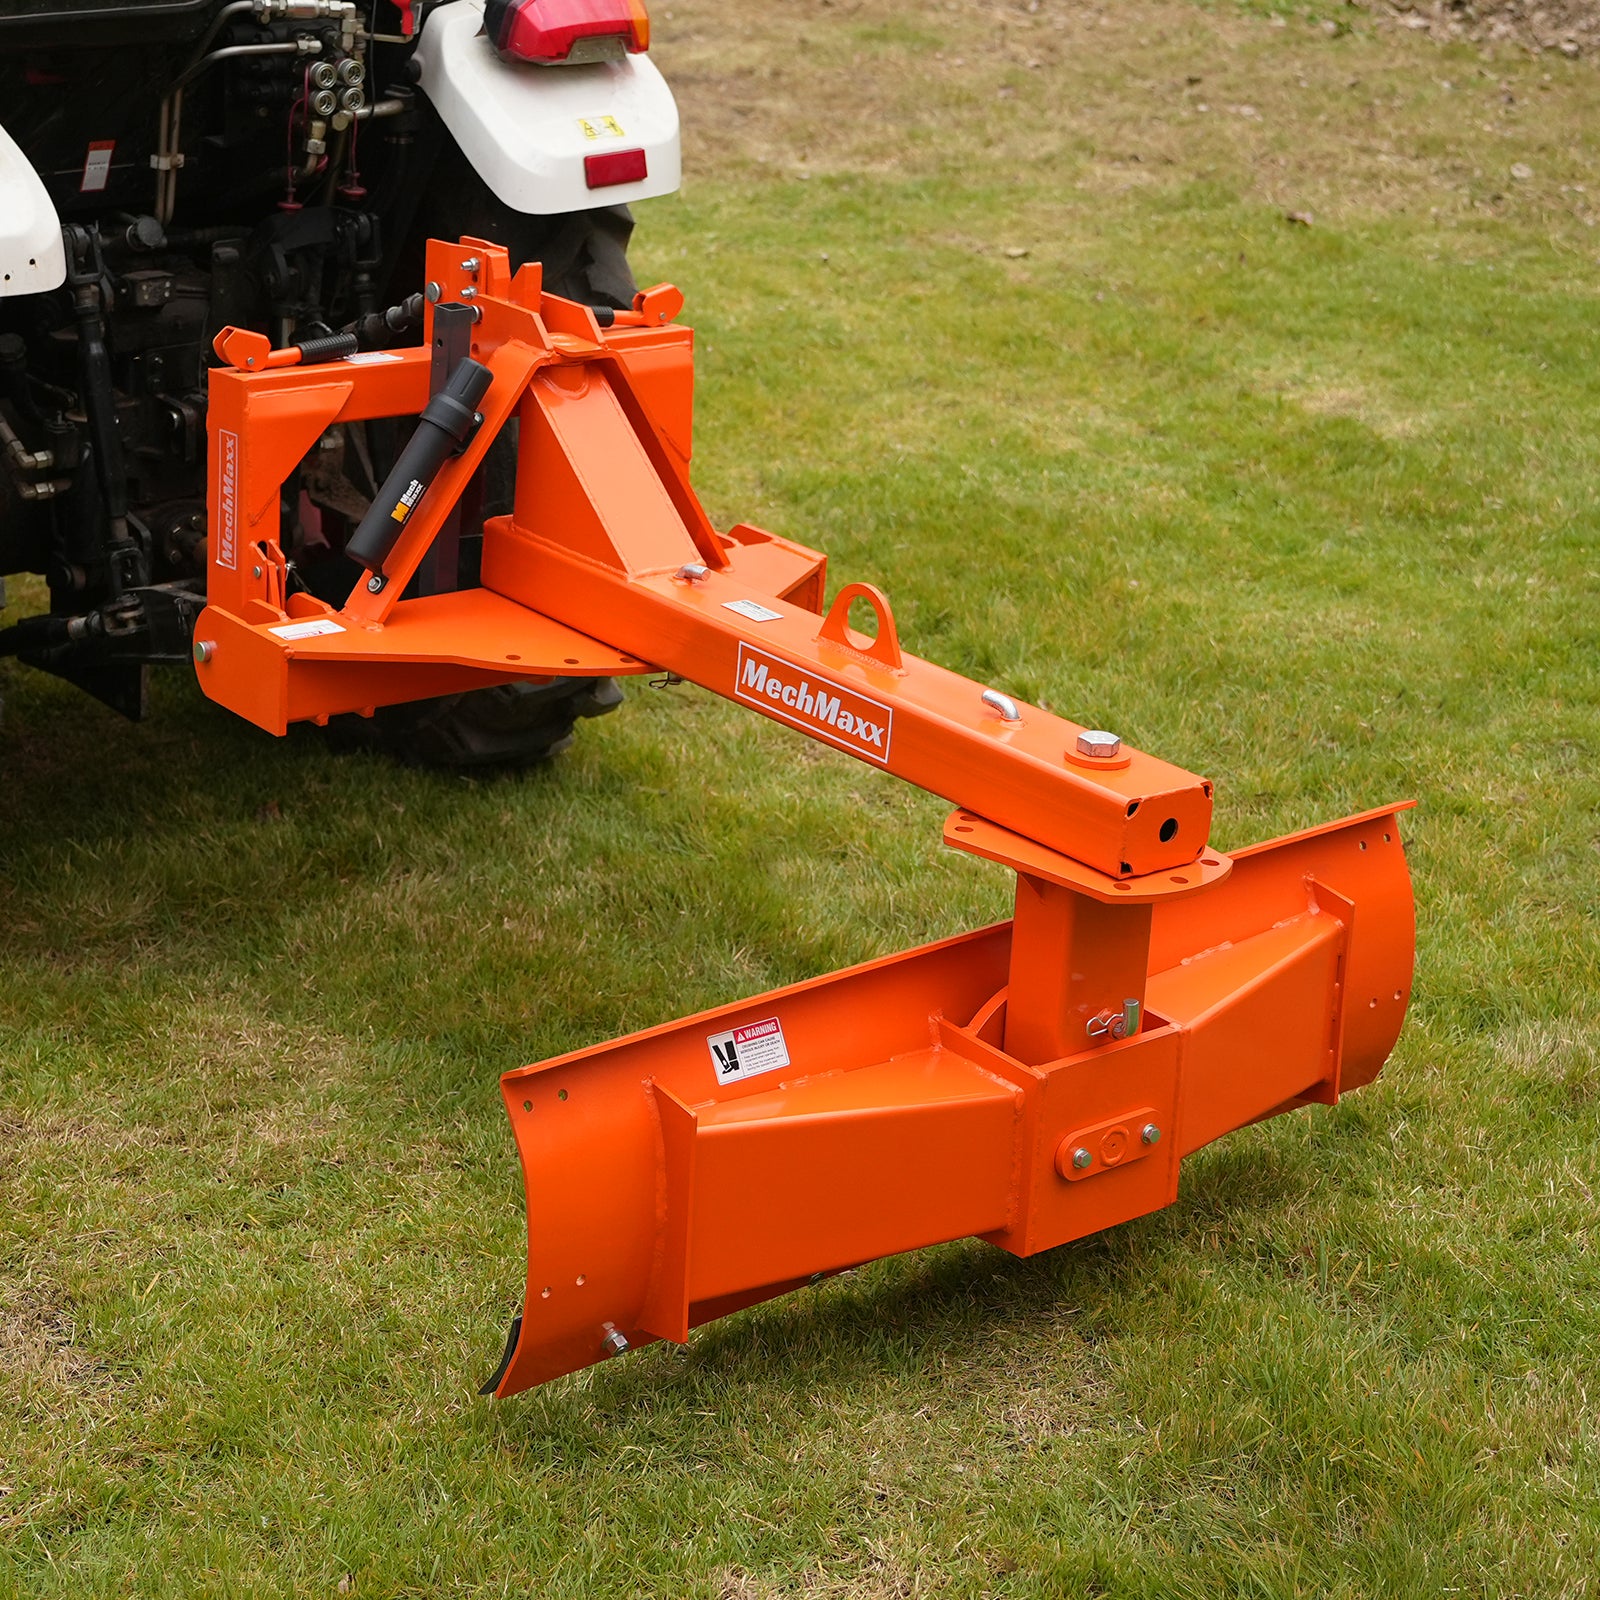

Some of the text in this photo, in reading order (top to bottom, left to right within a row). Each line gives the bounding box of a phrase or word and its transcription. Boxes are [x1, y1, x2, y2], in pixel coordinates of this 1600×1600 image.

[221, 436, 234, 563] MechMaxx
[400, 479, 419, 504] Mech
[406, 483, 424, 507] Maxx
[741, 658, 885, 748] MechMaxx
[744, 1021, 777, 1039] WARNING
